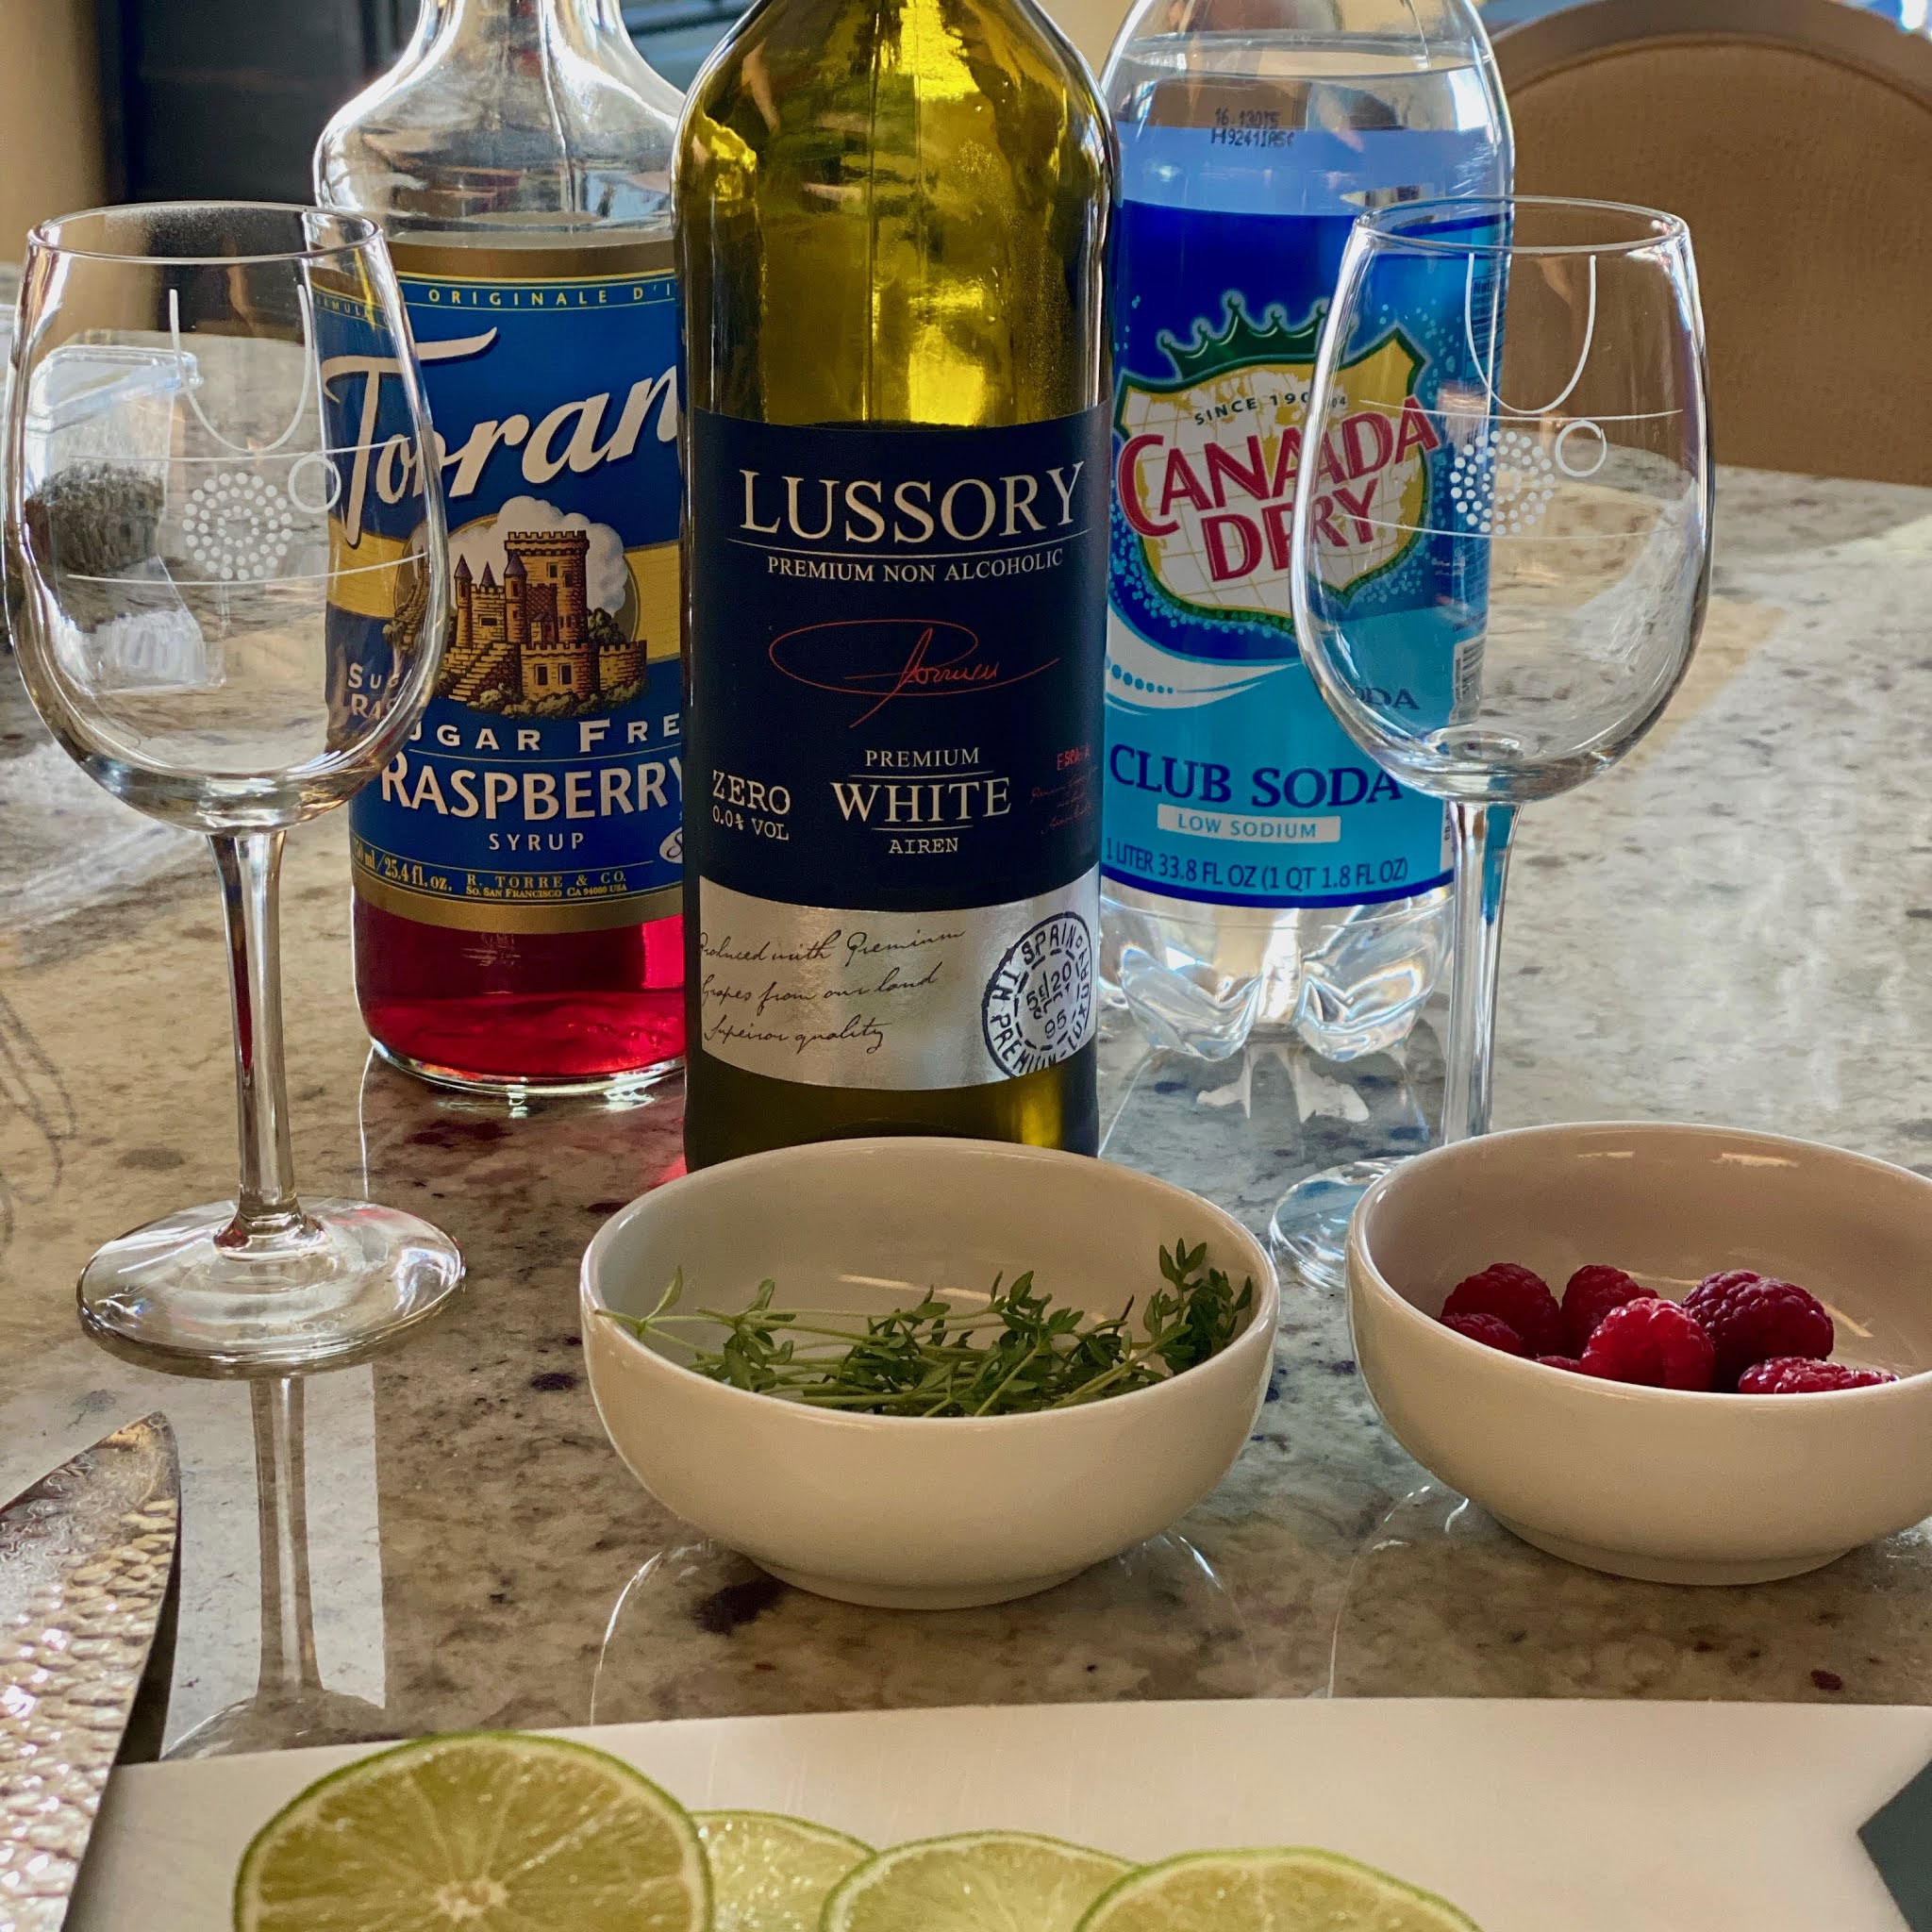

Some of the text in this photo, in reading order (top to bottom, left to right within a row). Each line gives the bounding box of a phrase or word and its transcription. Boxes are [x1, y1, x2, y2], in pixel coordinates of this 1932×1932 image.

[427, 288, 607, 306] ORIGINALE
[1194, 397, 1257, 426] SINCE
[321, 326, 678, 547] Toran
[1118, 394, 1440, 538] CANADA
[739, 460, 1085, 544] LUSSORY
[1201, 477, 1380, 583] DRY
[767, 547, 1063, 583] PREMIUM NON ALCOHOLIC
[865, 747, 980, 769] PREMIUM
[1109, 742, 1231, 804] CLUB
[1250, 766, 1404, 809] SODA
[712, 769, 791, 815] ZERO
[829, 776, 1011, 824] WHITE
[712, 805, 791, 841] 0.0% VOL
[1177, 813, 1318, 840] LOW SODIUM
[489, 832, 585, 852] SYRUP
[888, 837, 959, 856] AIREN
[429, 875, 453, 892] oz.
[467, 874, 483, 887] R.
[495, 875, 563, 889] TORRE
[575, 874, 588, 887] &
[1115, 843, 1155, 874] LITER
[1158, 854, 1196, 883] 33.8
[1203, 859, 1224, 887] FL
[1227, 865, 1257, 889] OZ
[1261, 864, 1278, 891] (1
[1285, 866, 1317, 891] QT
[1322, 864, 1352, 890] 1.8
[1357, 860, 1375, 886] FL
[1378, 856, 1408, 884] OZ)
[1022, 922, 1076, 966] SPAIN
[757, 981, 817, 1017] from
